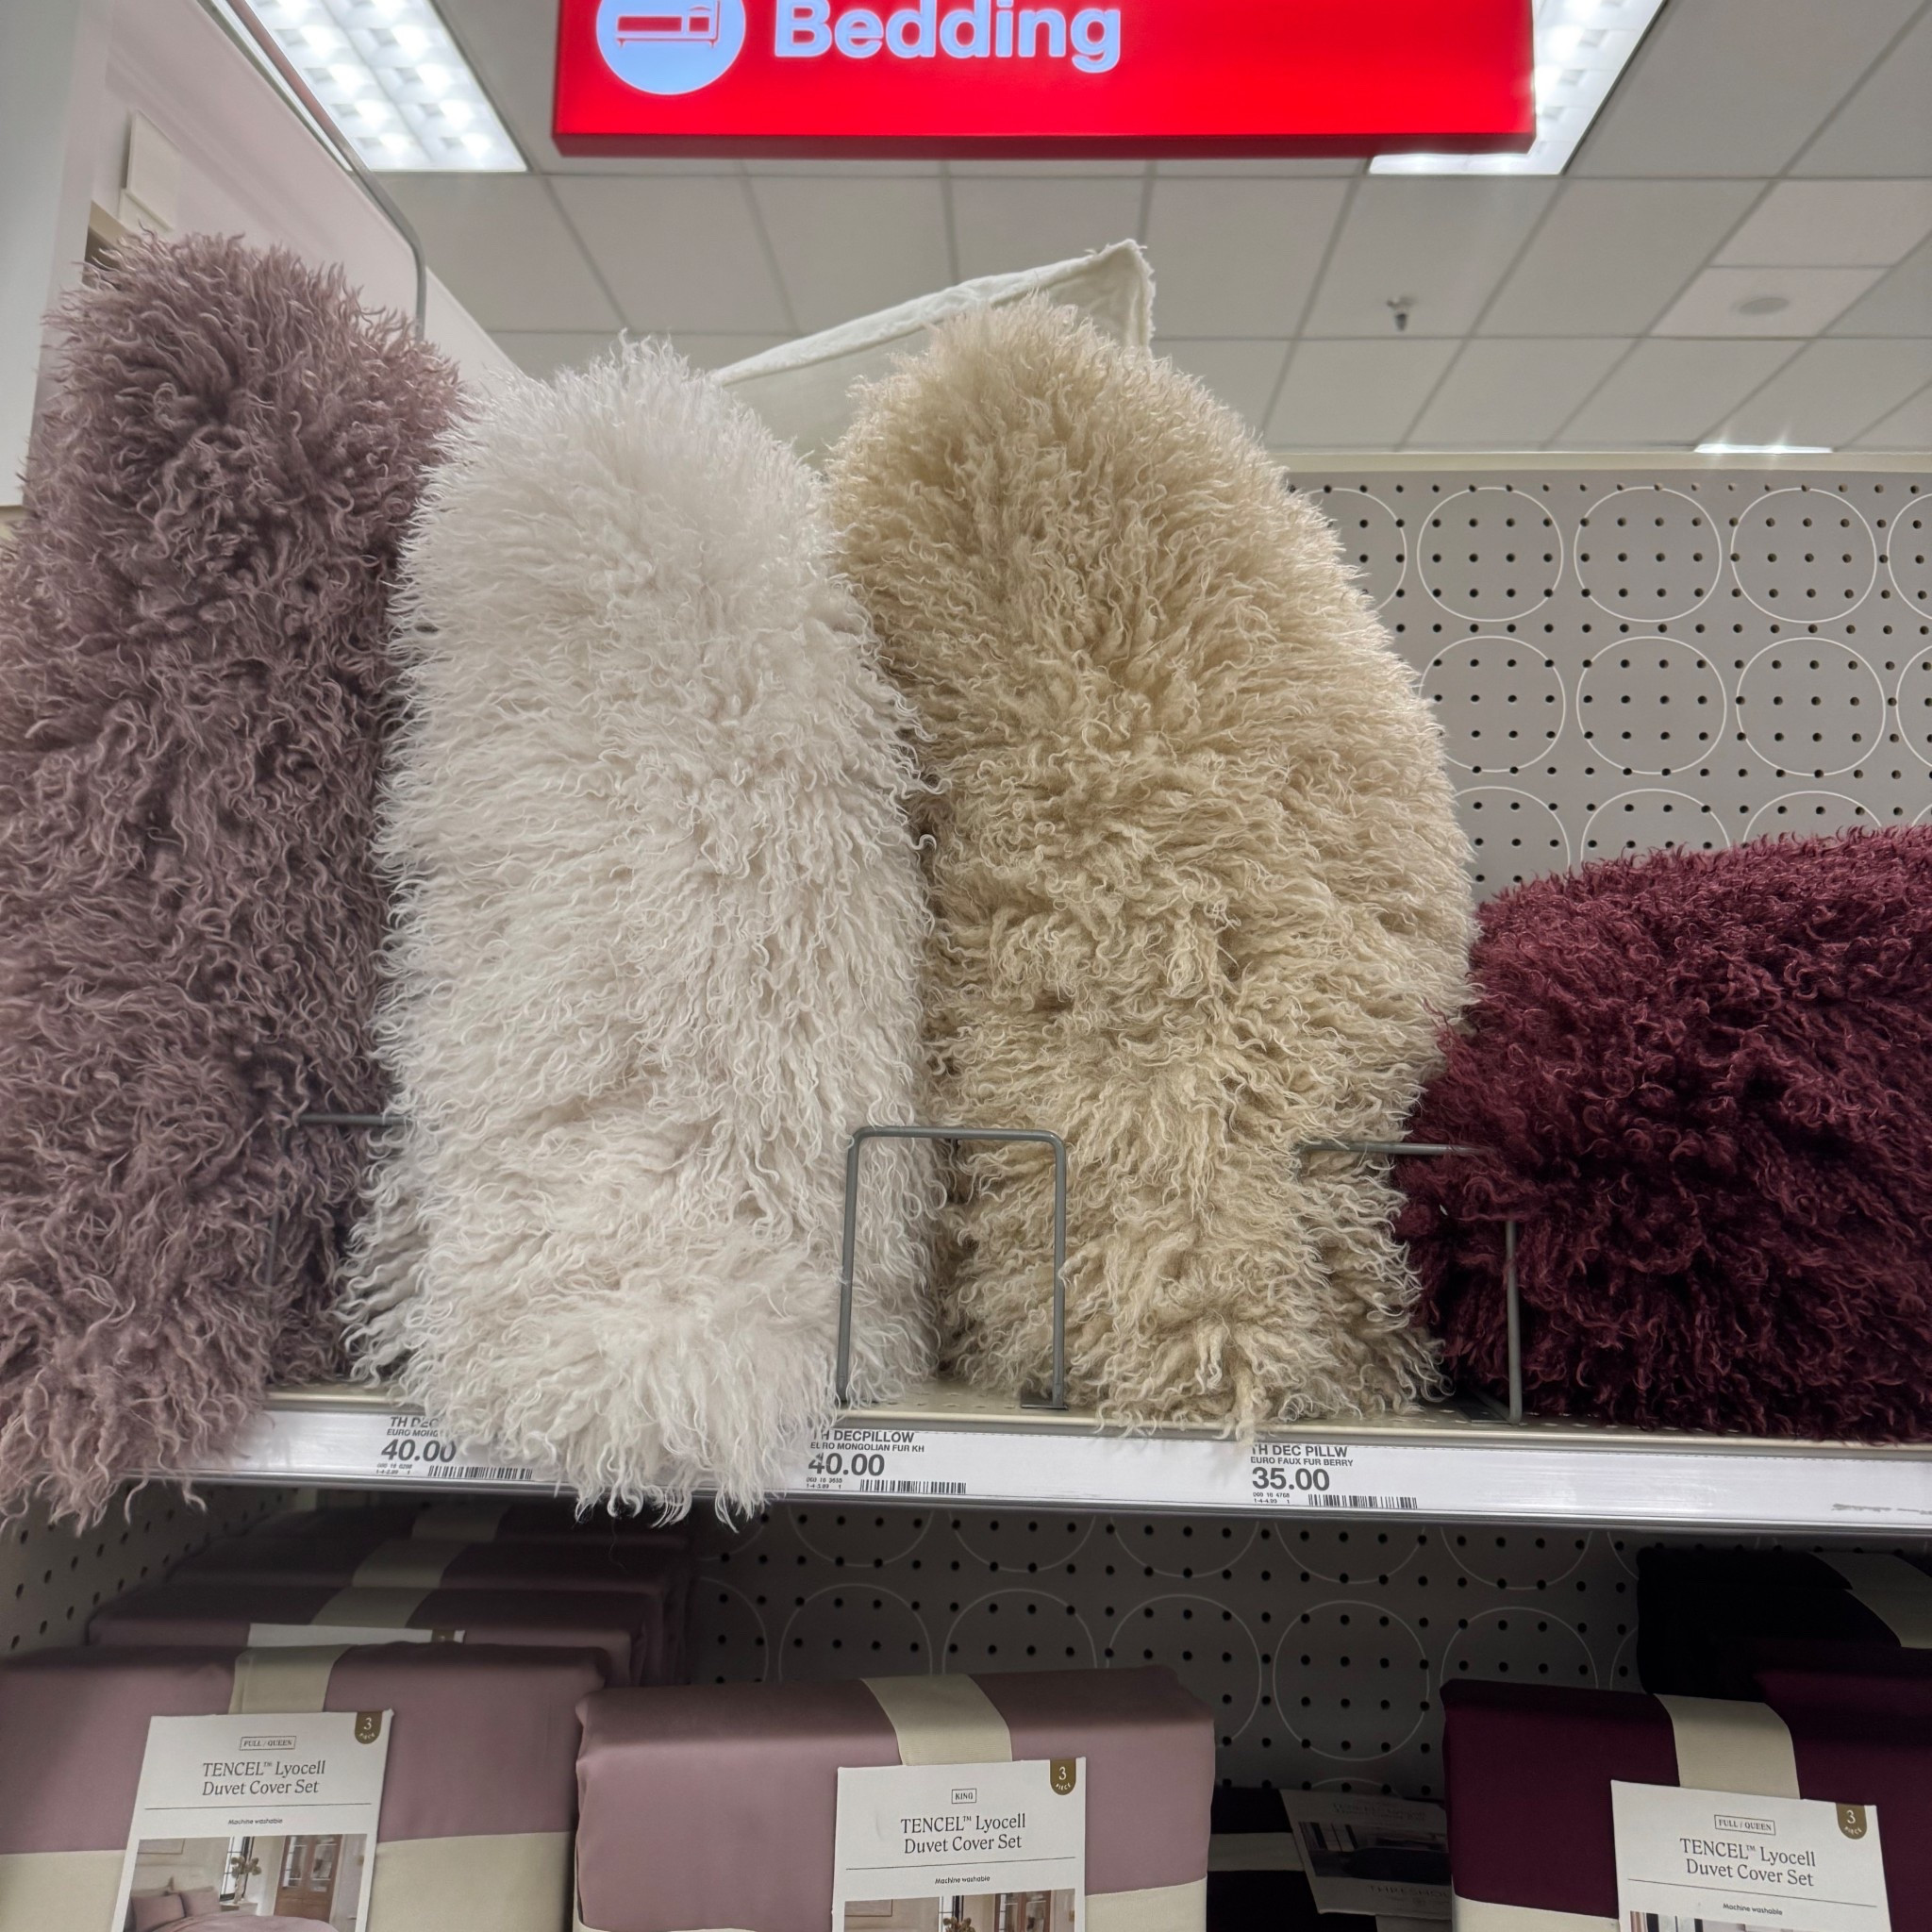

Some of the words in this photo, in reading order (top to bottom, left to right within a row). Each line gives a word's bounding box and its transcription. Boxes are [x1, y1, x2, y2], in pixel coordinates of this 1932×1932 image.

[774, 0, 1122, 74] Bedding
[834, 1430, 914, 1443] DECPILLOW
[381, 1439, 457, 1462] 40.00
[837, 1442, 890, 1452] MONGOLIAN
[1272, 1444, 1302, 1457] DEC
[1306, 1445, 1348, 1457] PILLW
[808, 1452, 885, 1476] 40.00
[1324, 1458, 1354, 1467] BERRY
[1252, 1466, 1330, 1491] 35.00
[363, 1717, 373, 1730] 3
[275, 1760, 325, 1778] Lyocell
[1058, 1766, 1067, 1781] 3
[202, 1781, 246, 1796] Duvet
[249, 1779, 291, 1795] Cover
[294, 1779, 319, 1793] Set
[975, 1813, 1026, 1834] Lyocell
[1846, 1809, 1856, 1824] 3
[1718, 1819, 1739, 1828] FULL
[1744, 1822, 1772, 1832] QUEEN
[904, 1837, 948, 1854] Duvet
[952, 1836, 994, 1851] Cover
[998, 1834, 1022, 1849] Set
[1760, 1846, 1816, 1867] Lyocell
[935, 1876, 960, 1885] Machine
[961, 1874, 991, 1883] washable
[1686, 1858, 1733, 1878] Duvet
[1737, 1865, 1783, 1883] Cover
[1787, 1870, 1814, 1887] Set
[1723, 1902, 1751, 1912] Machine
[1751, 1907, 1783, 1916] washable
